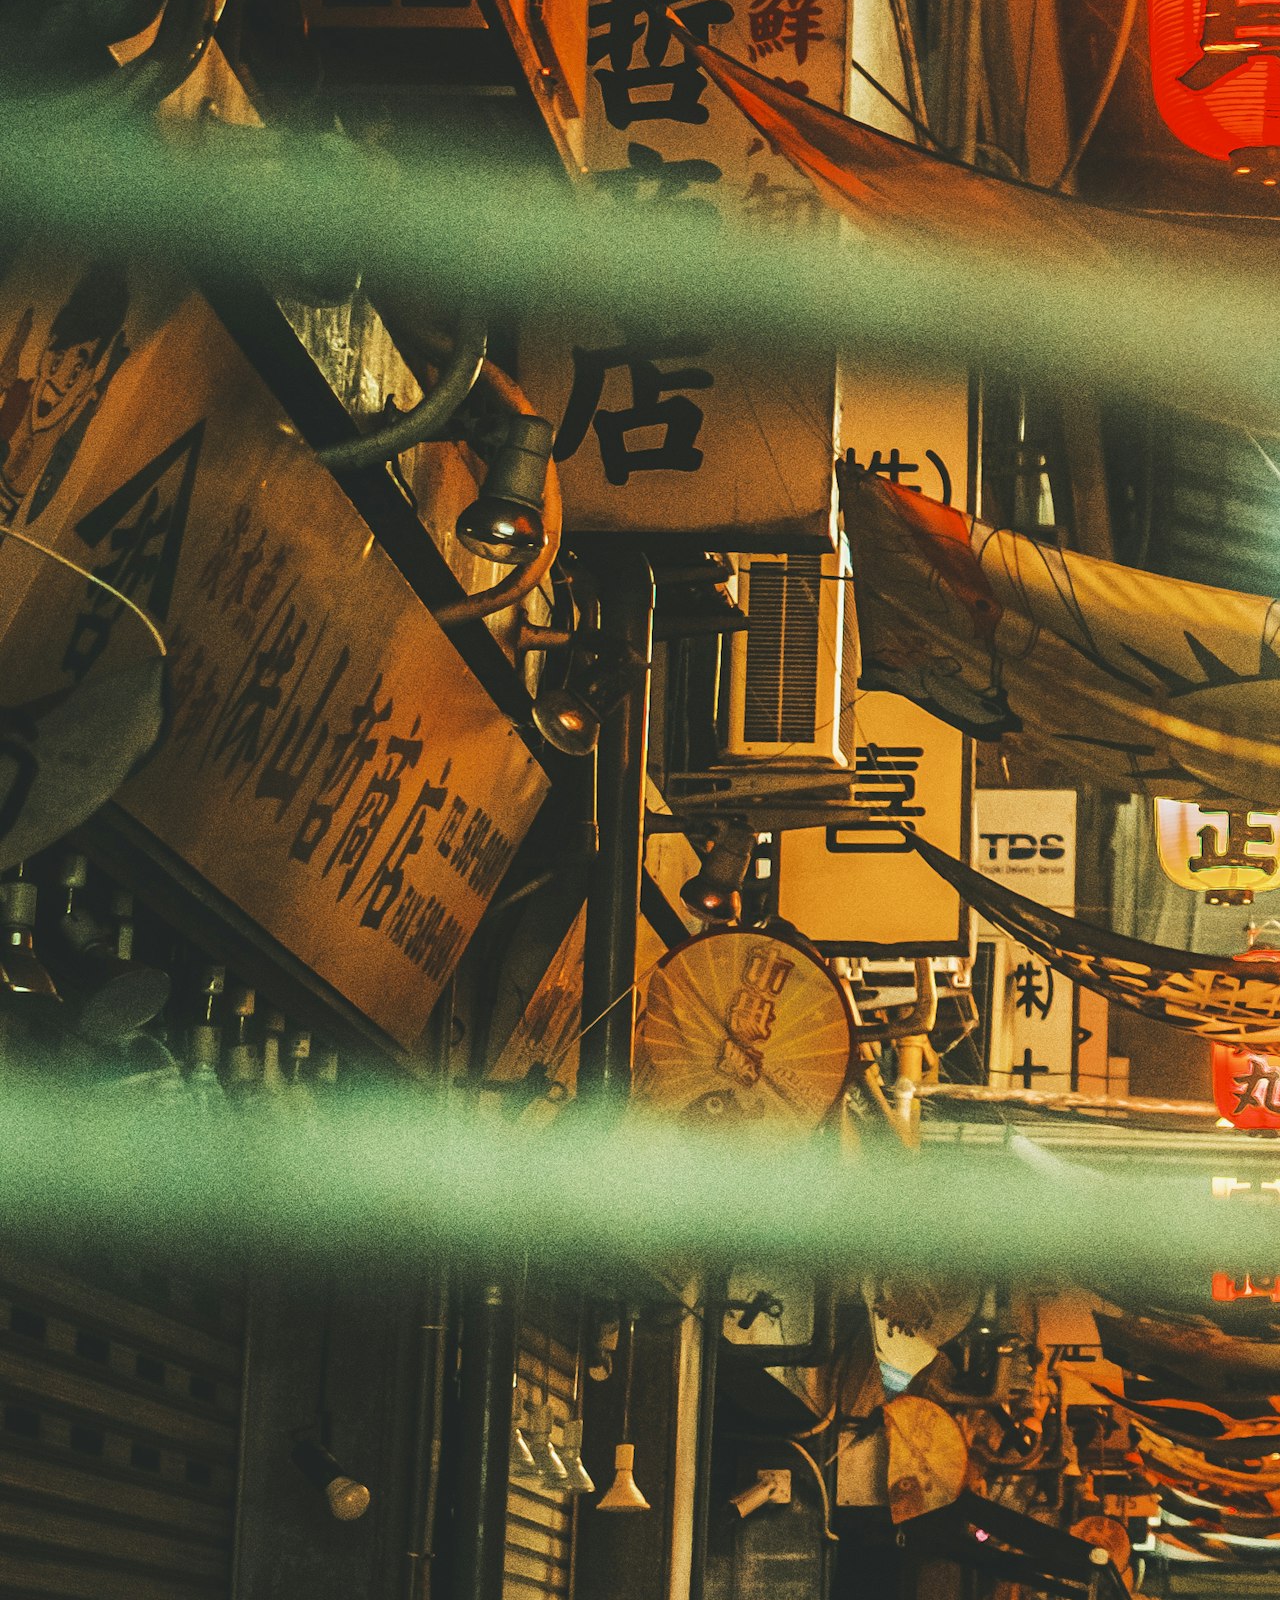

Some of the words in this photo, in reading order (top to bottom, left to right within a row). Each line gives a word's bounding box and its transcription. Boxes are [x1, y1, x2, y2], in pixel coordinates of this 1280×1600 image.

[206, 574, 448, 930] (株)山哲商店
[979, 832, 1066, 862] TDS
